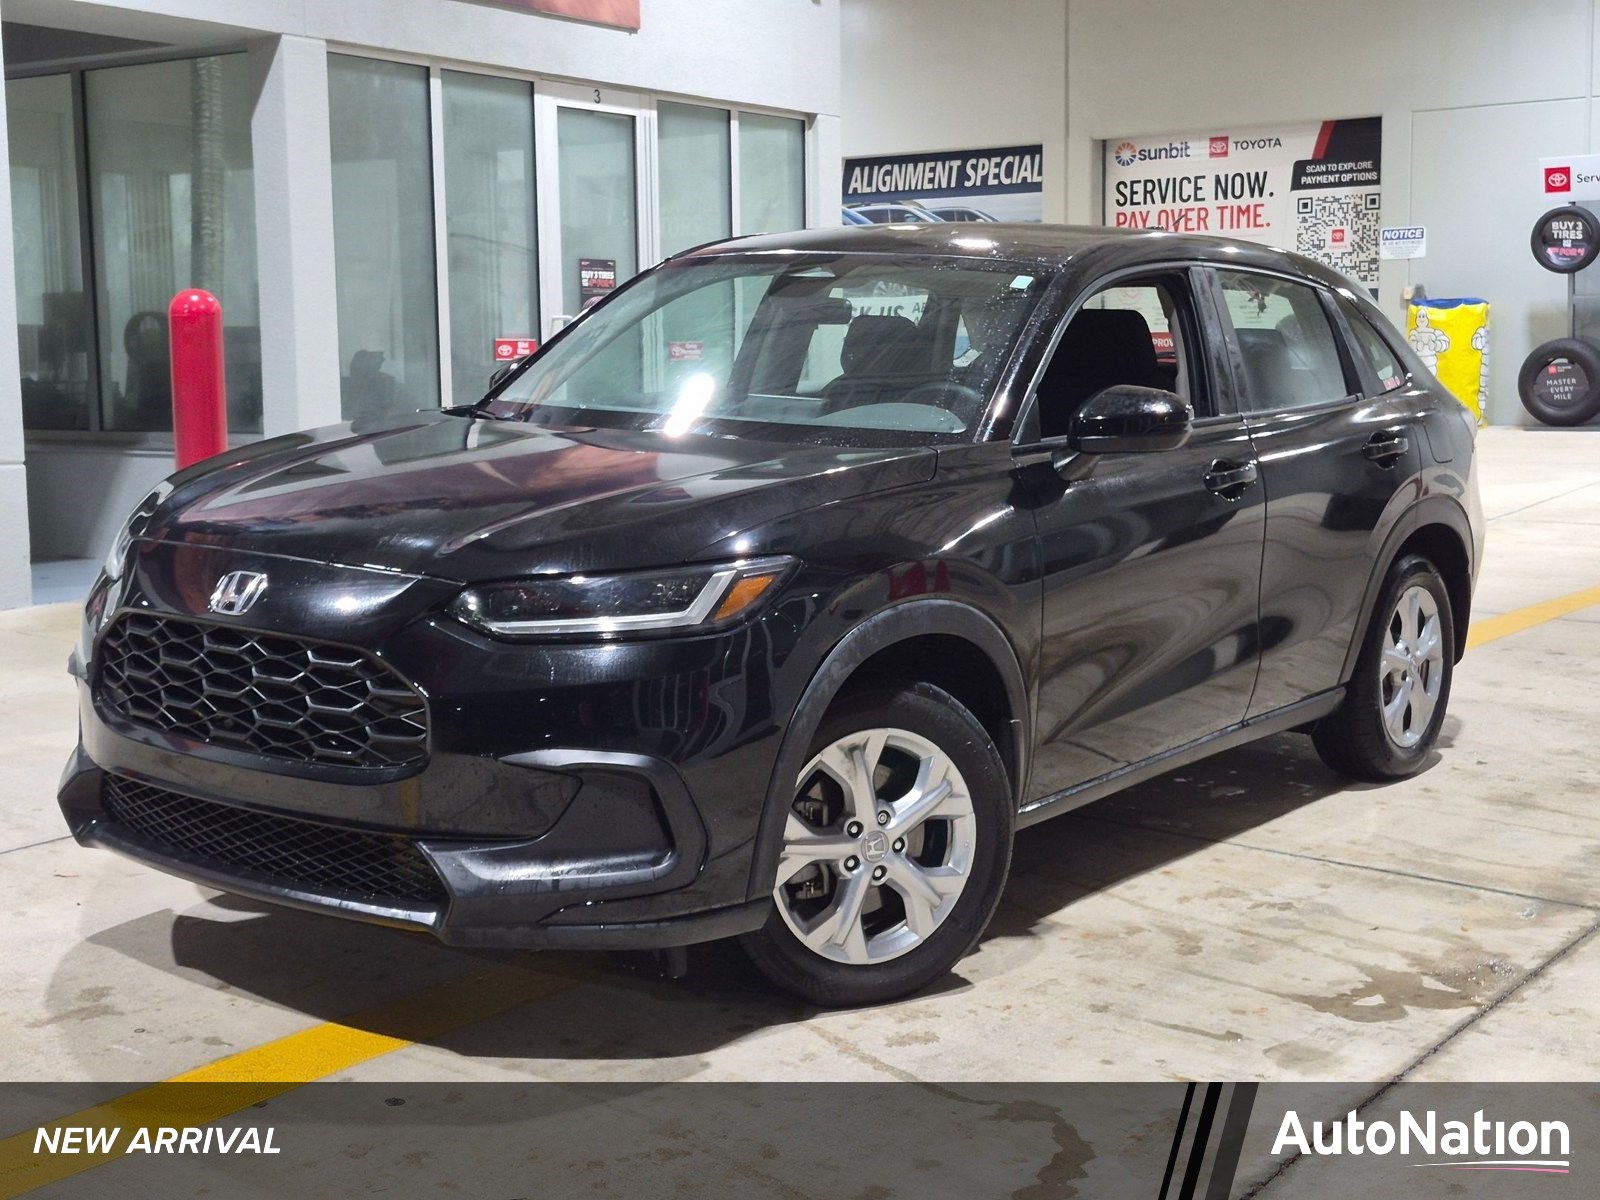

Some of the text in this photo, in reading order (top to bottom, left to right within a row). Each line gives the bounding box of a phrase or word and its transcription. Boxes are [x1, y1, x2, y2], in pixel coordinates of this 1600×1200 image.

[593, 88, 601, 104] 3
[1138, 141, 1190, 161] sunbit
[1233, 138, 1282, 151] TOYOTA
[1306, 161, 1373, 173] SCAN TO EXPLORE
[848, 154, 1042, 194] ALIGNMENT SPECIAL
[1301, 172, 1377, 185] PAYMENT OPTIONS
[1115, 171, 1274, 207] SERVICE NOW.
[1157, 206, 1209, 232] OVER
[1216, 203, 1271, 230] TIME.
[1551, 221, 1583, 230] BUY 3
[1383, 229, 1423, 239] NOTICE
[1551, 230, 1583, 239] TIRES
[1546, 378, 1576, 386] MASTER
